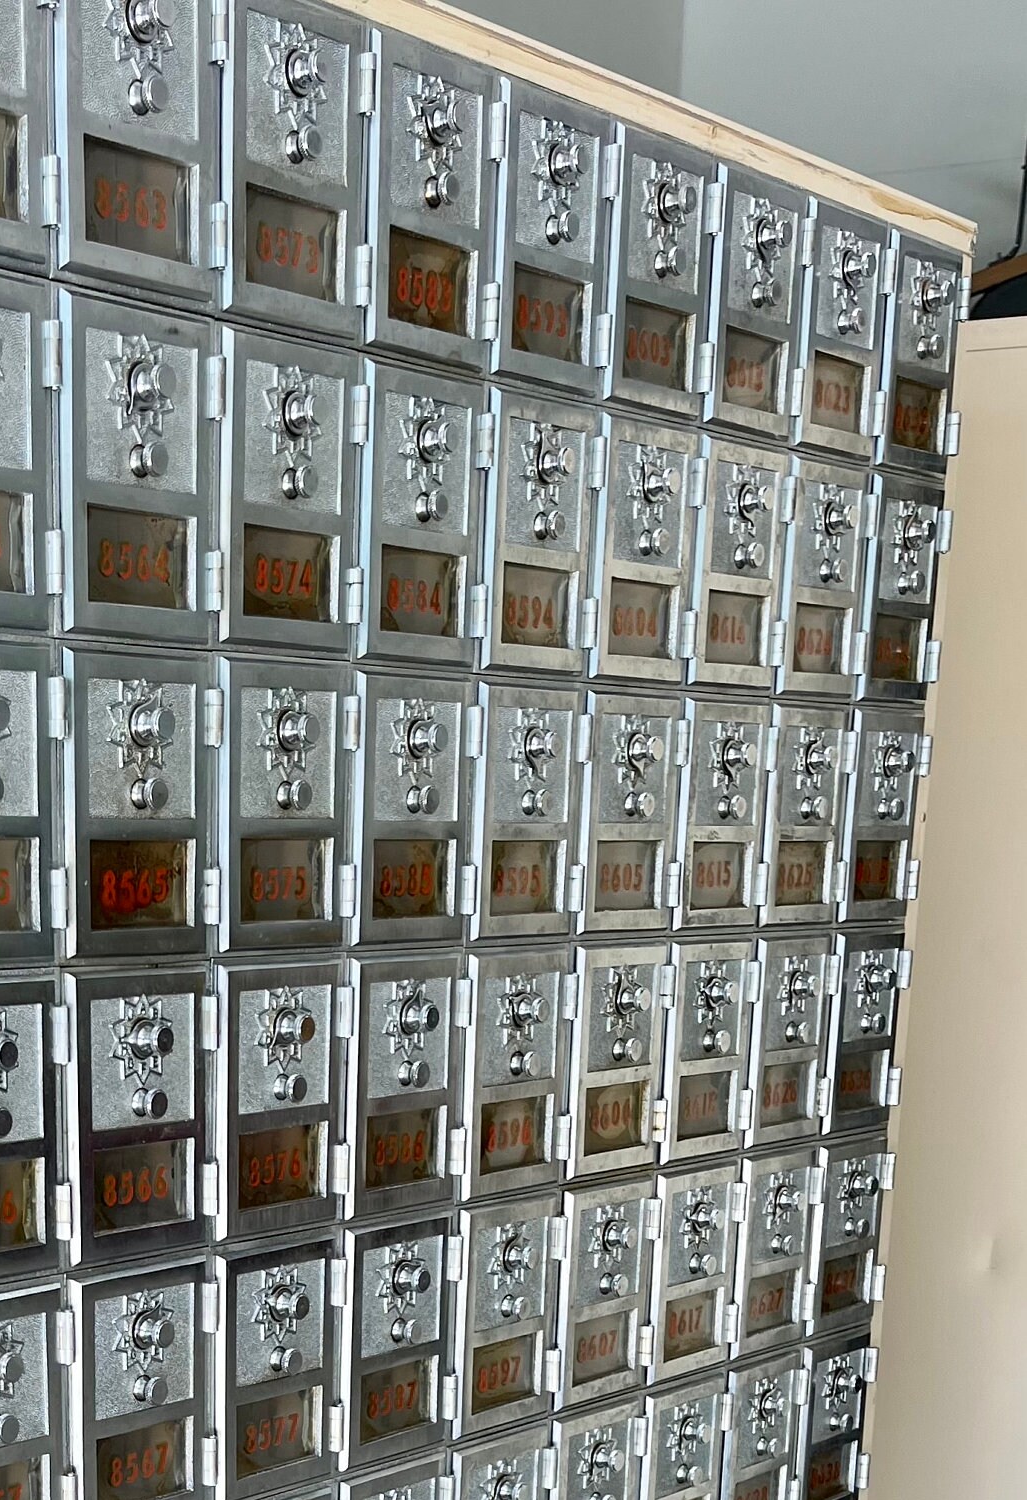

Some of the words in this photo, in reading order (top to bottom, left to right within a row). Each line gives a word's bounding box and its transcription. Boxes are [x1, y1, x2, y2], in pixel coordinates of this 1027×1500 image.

[95, 177, 167, 231] 8563
[258, 224, 319, 274] 8573
[517, 294, 567, 338] 8593
[627, 326, 671, 367] 8603
[101, 538, 170, 585] 8564
[255, 554, 313, 596] 8574
[387, 574, 442, 615] 8584
[505, 594, 554, 629] 8594
[613, 605, 657, 638] 8604
[100, 869, 169, 913] 8565
[252, 868, 307, 902] 8575
[381, 864, 433, 897] 8585
[494, 864, 542, 897] 8595
[600, 864, 643, 893] 8605
[485, 1115, 531, 1152] 8596
[590, 1098, 632, 1133] 8606
[375, 1130, 425, 1167] 8586
[104, 1168, 168, 1208] 8566
[250, 1149, 302, 1188] 8576
[577, 1330, 617, 1363] 8607
[477, 1356, 520, 1393] 8597
[367, 1379, 417, 1419] 8587
[246, 1414, 299, 1454] 8577
[110, 1442, 169, 1487] 8567
